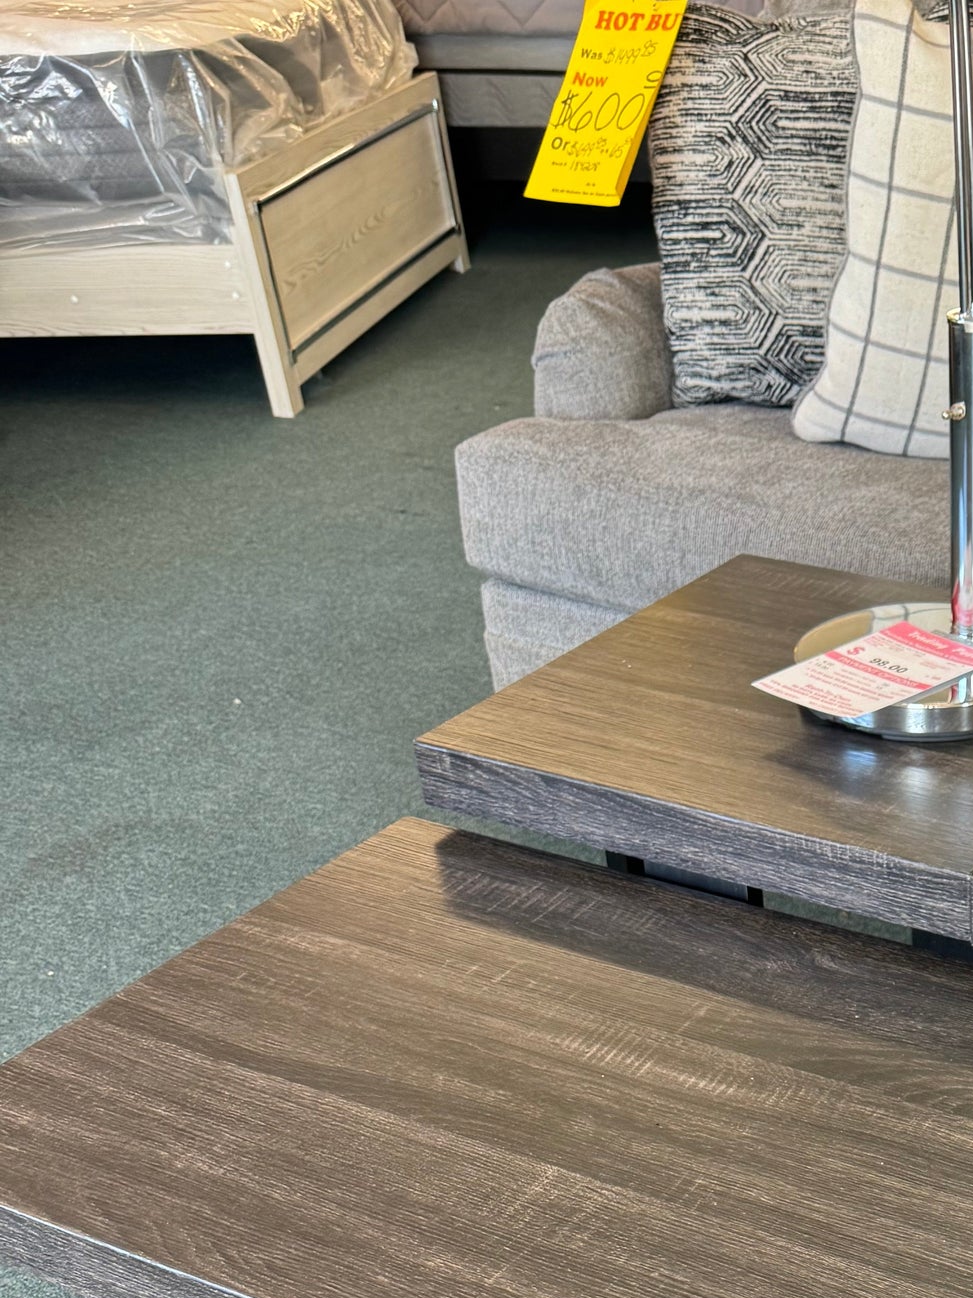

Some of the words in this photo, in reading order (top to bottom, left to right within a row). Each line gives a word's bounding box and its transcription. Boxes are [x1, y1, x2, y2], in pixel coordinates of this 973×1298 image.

[595, 10, 645, 31] HOT
[645, 13, 682, 31] BU
[581, 48, 602, 60] Was
[572, 72, 608, 87] Now
[551, 136, 570, 151] Or
[869, 658, 908, 673] 98.00
